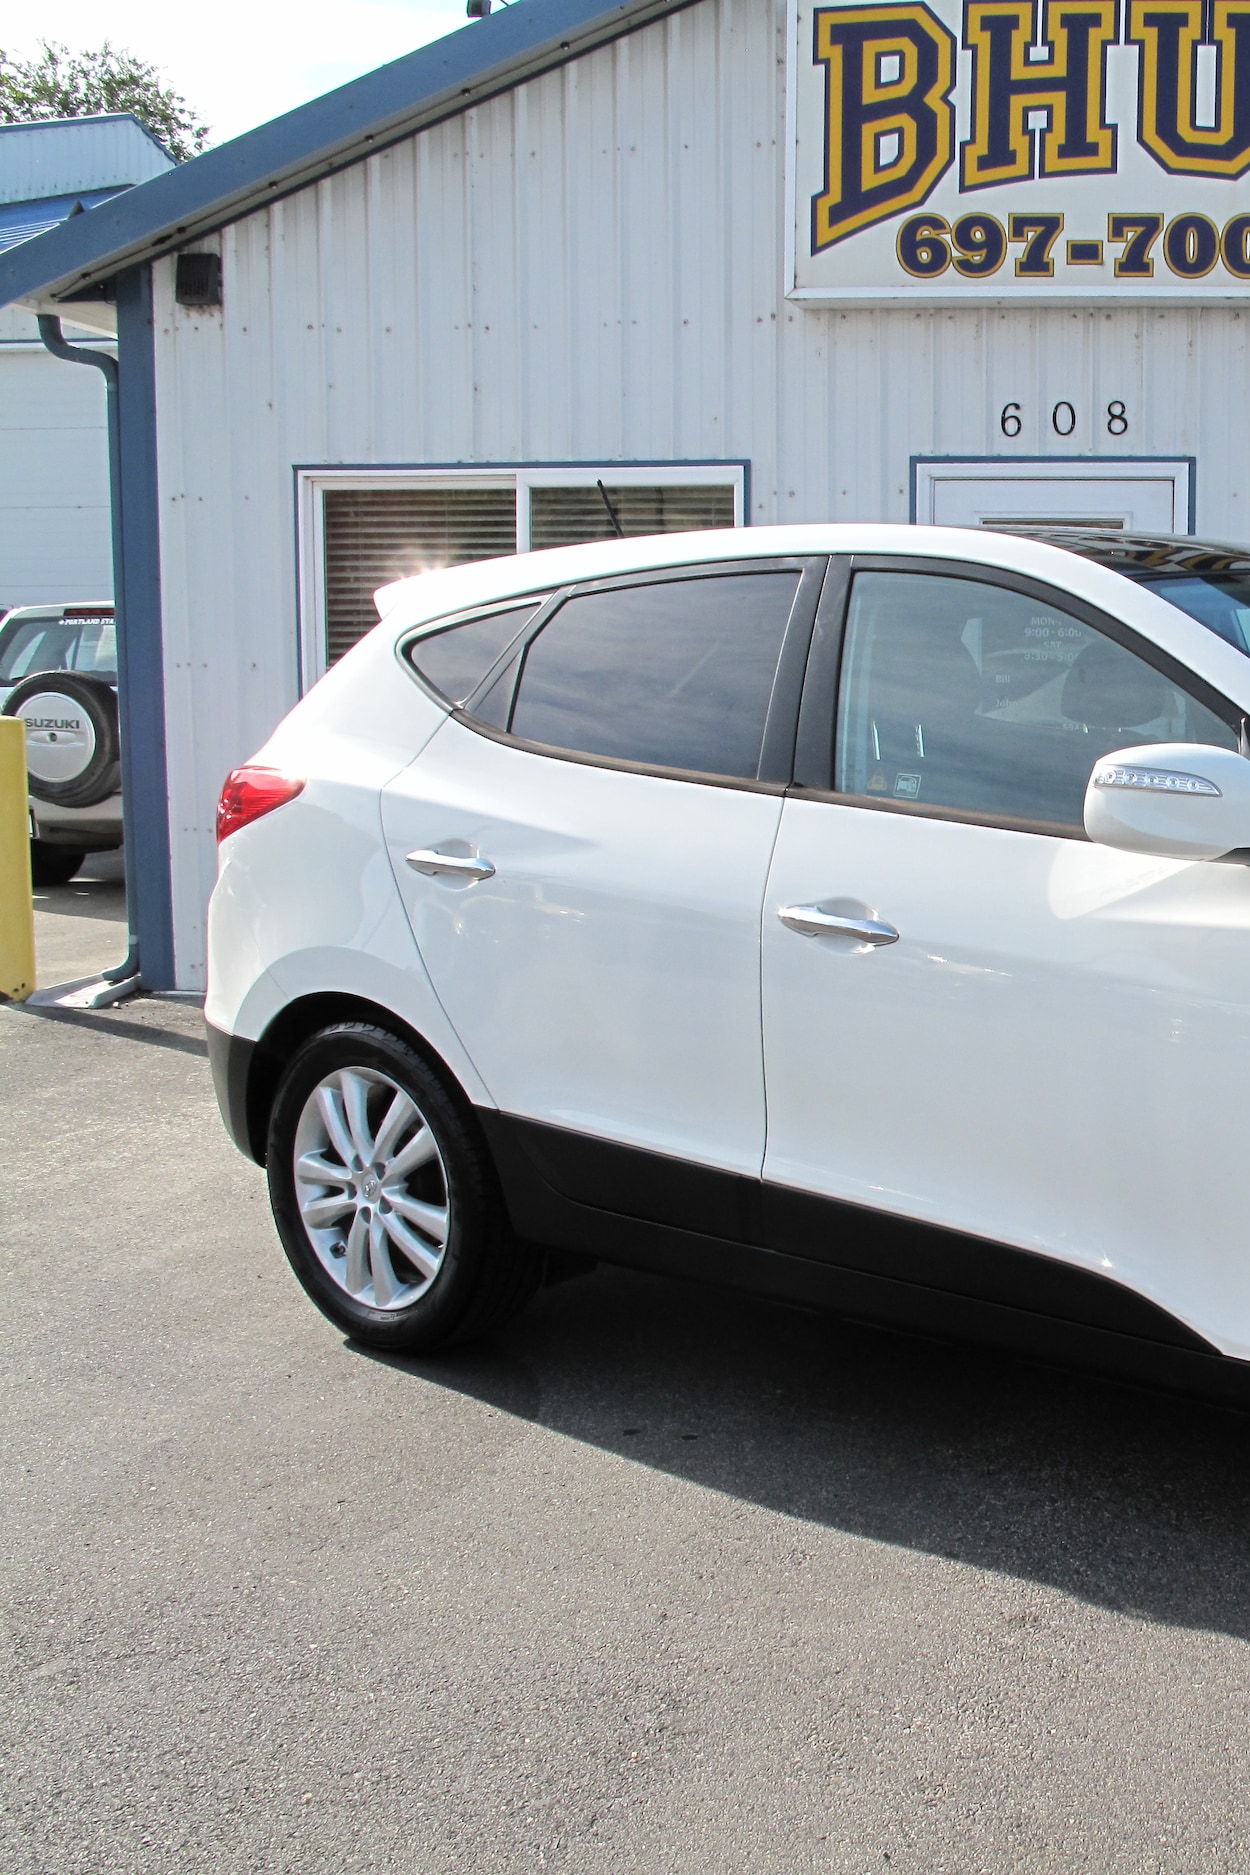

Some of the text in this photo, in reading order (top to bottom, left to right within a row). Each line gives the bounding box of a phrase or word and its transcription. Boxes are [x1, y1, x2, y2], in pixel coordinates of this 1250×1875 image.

[100, 617, 116, 625] STA
[1024, 627, 1049, 638] 9:00
[25, 718, 80, 730] SUZUKI
